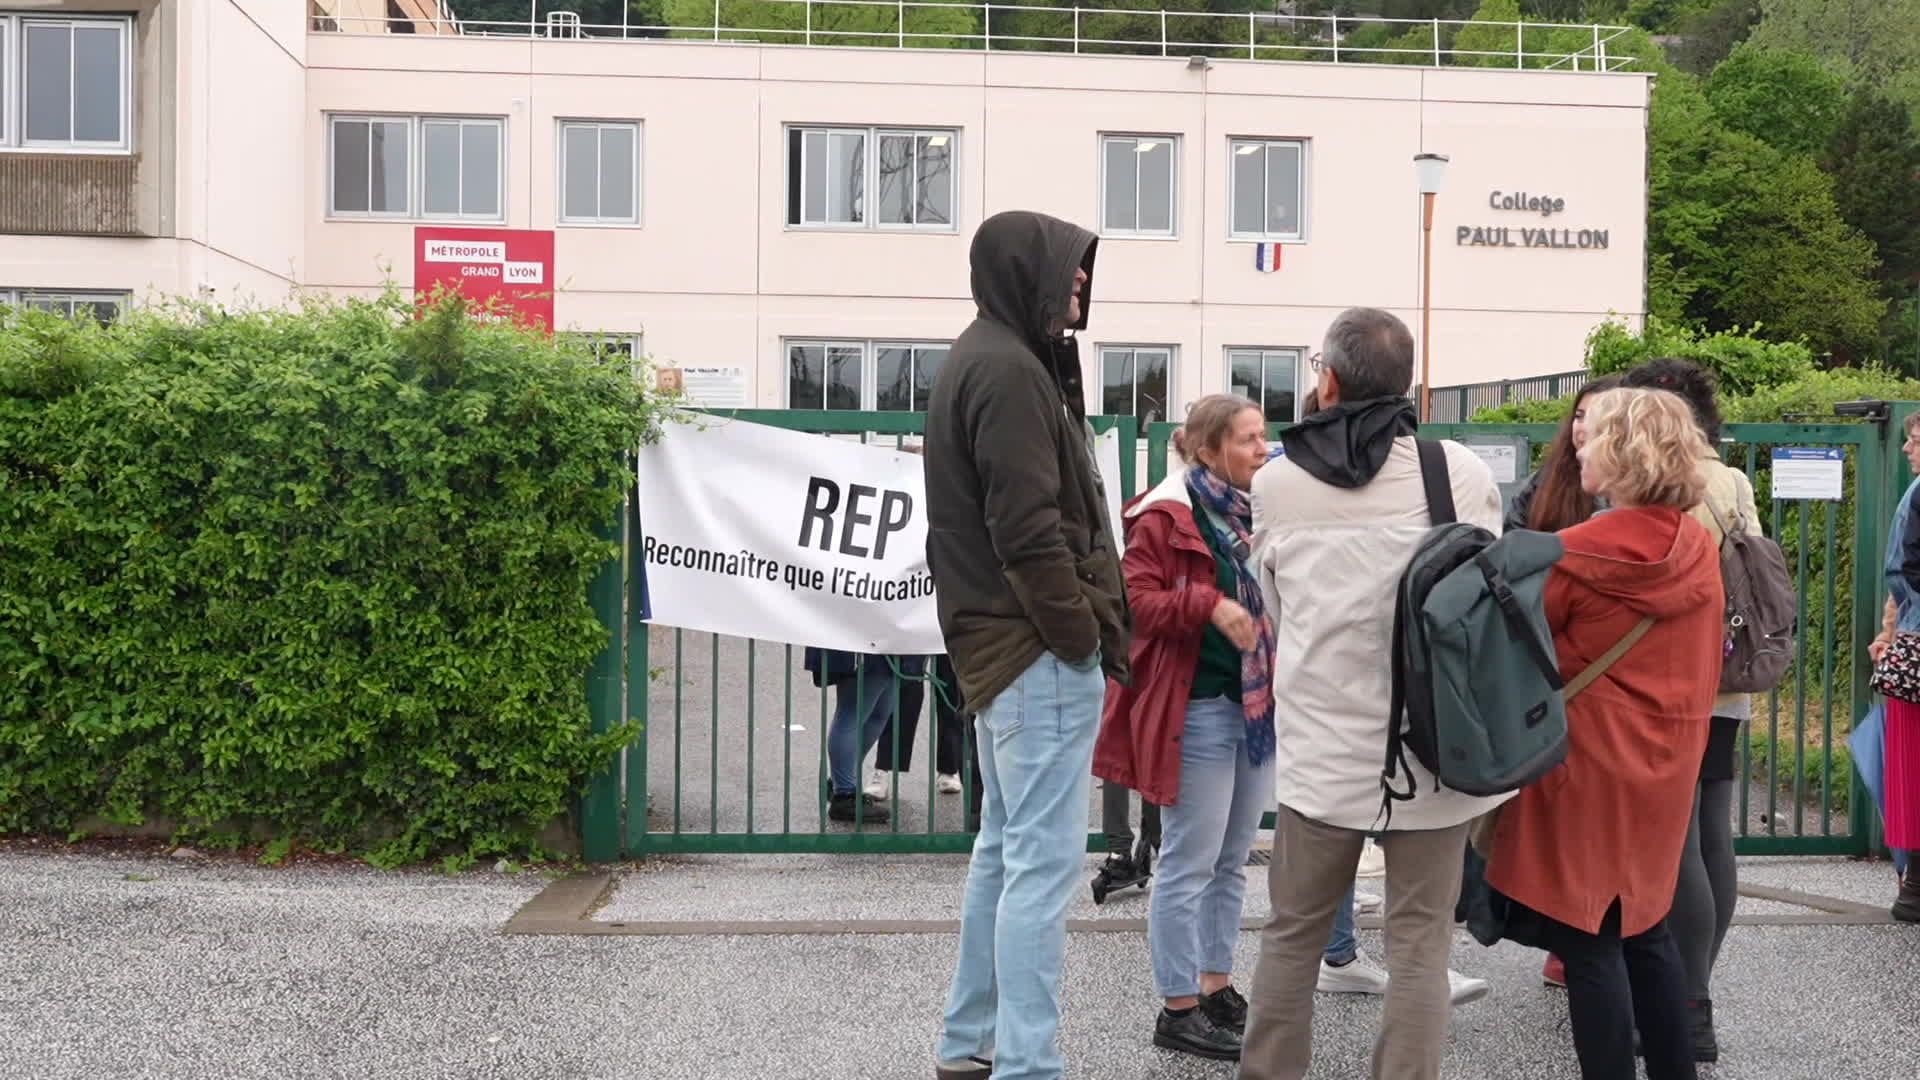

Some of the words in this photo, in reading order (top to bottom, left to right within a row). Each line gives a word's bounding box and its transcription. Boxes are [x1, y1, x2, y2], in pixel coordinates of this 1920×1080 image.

[1456, 225, 1516, 247] PAUL
[1521, 227, 1609, 249] VALLON
[431, 246, 500, 257] MÉTROPOLE
[461, 266, 500, 277] GRAND
[509, 267, 537, 277] LYON
[798, 476, 913, 560] REP
[644, 536, 778, 581] Reconnaître
[784, 564, 824, 591] que
[831, 567, 934, 601] l'Educatio
